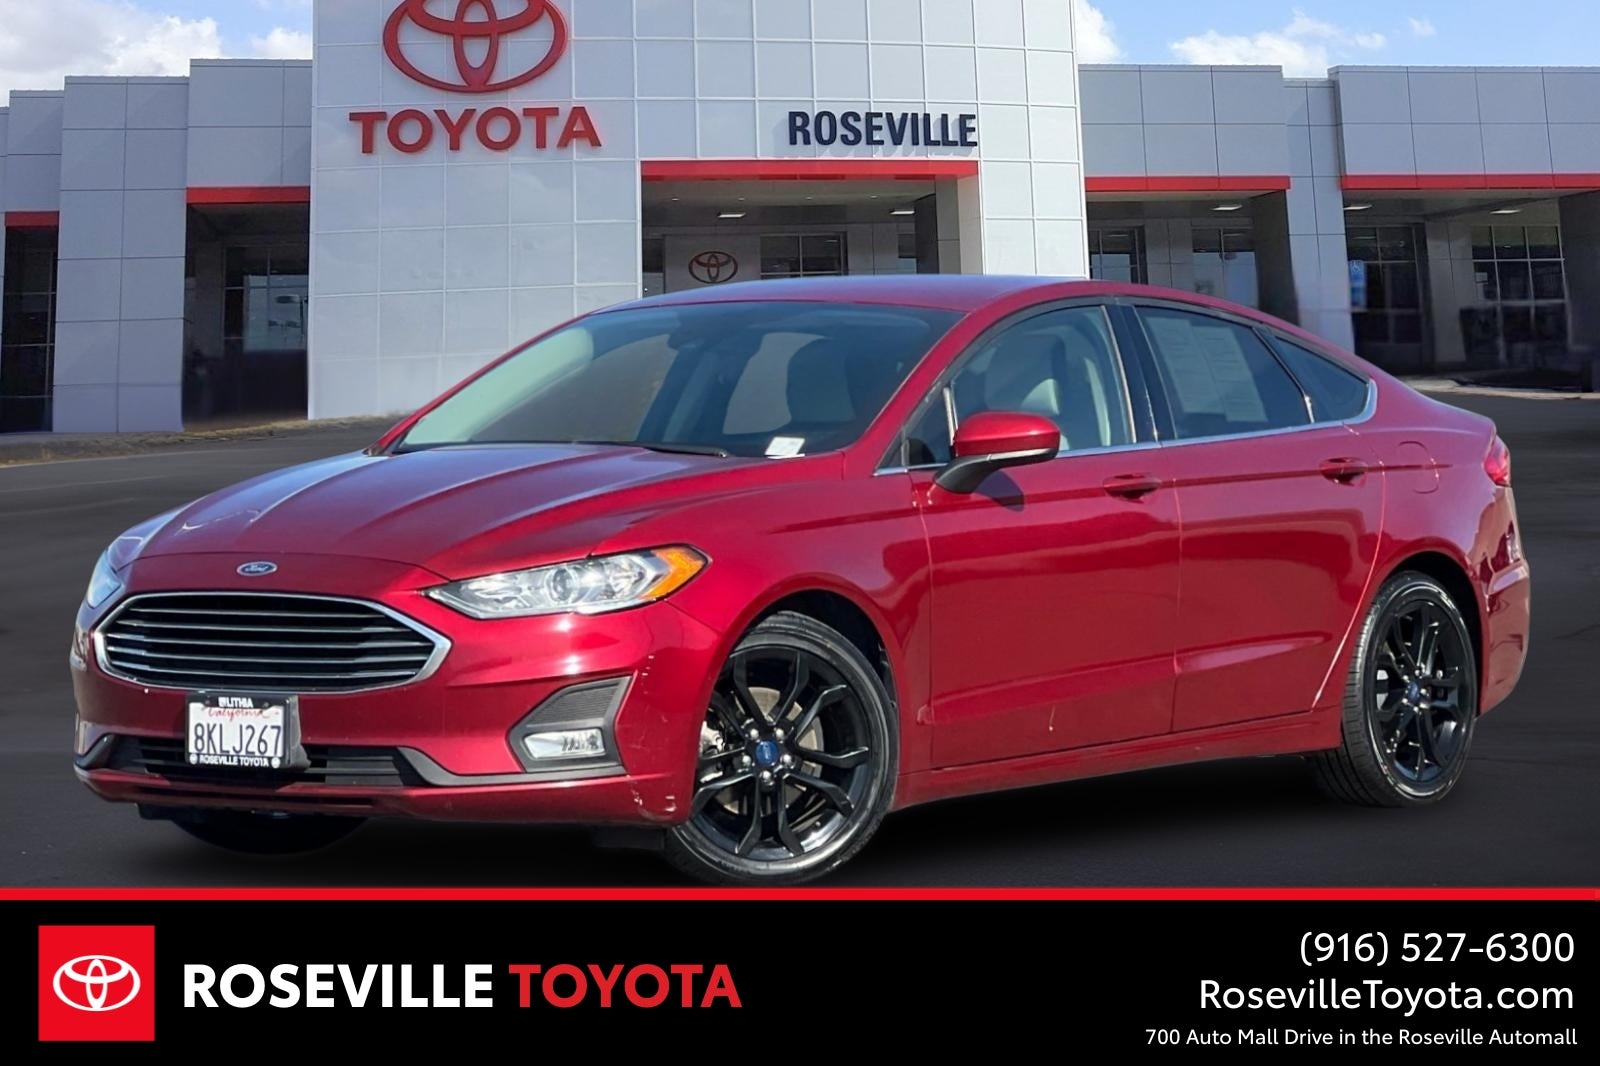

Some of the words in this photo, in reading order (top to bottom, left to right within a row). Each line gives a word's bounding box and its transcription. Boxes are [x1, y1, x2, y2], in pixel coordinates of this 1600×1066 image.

[349, 106, 602, 154] TOYOTA
[788, 110, 978, 148] ROSEVILLE
[227, 697, 254, 708] LITHIA
[194, 722, 282, 757] 8KLJ267
[199, 755, 239, 766] ROSEVILLE
[240, 757, 270, 768] TOYOTA
